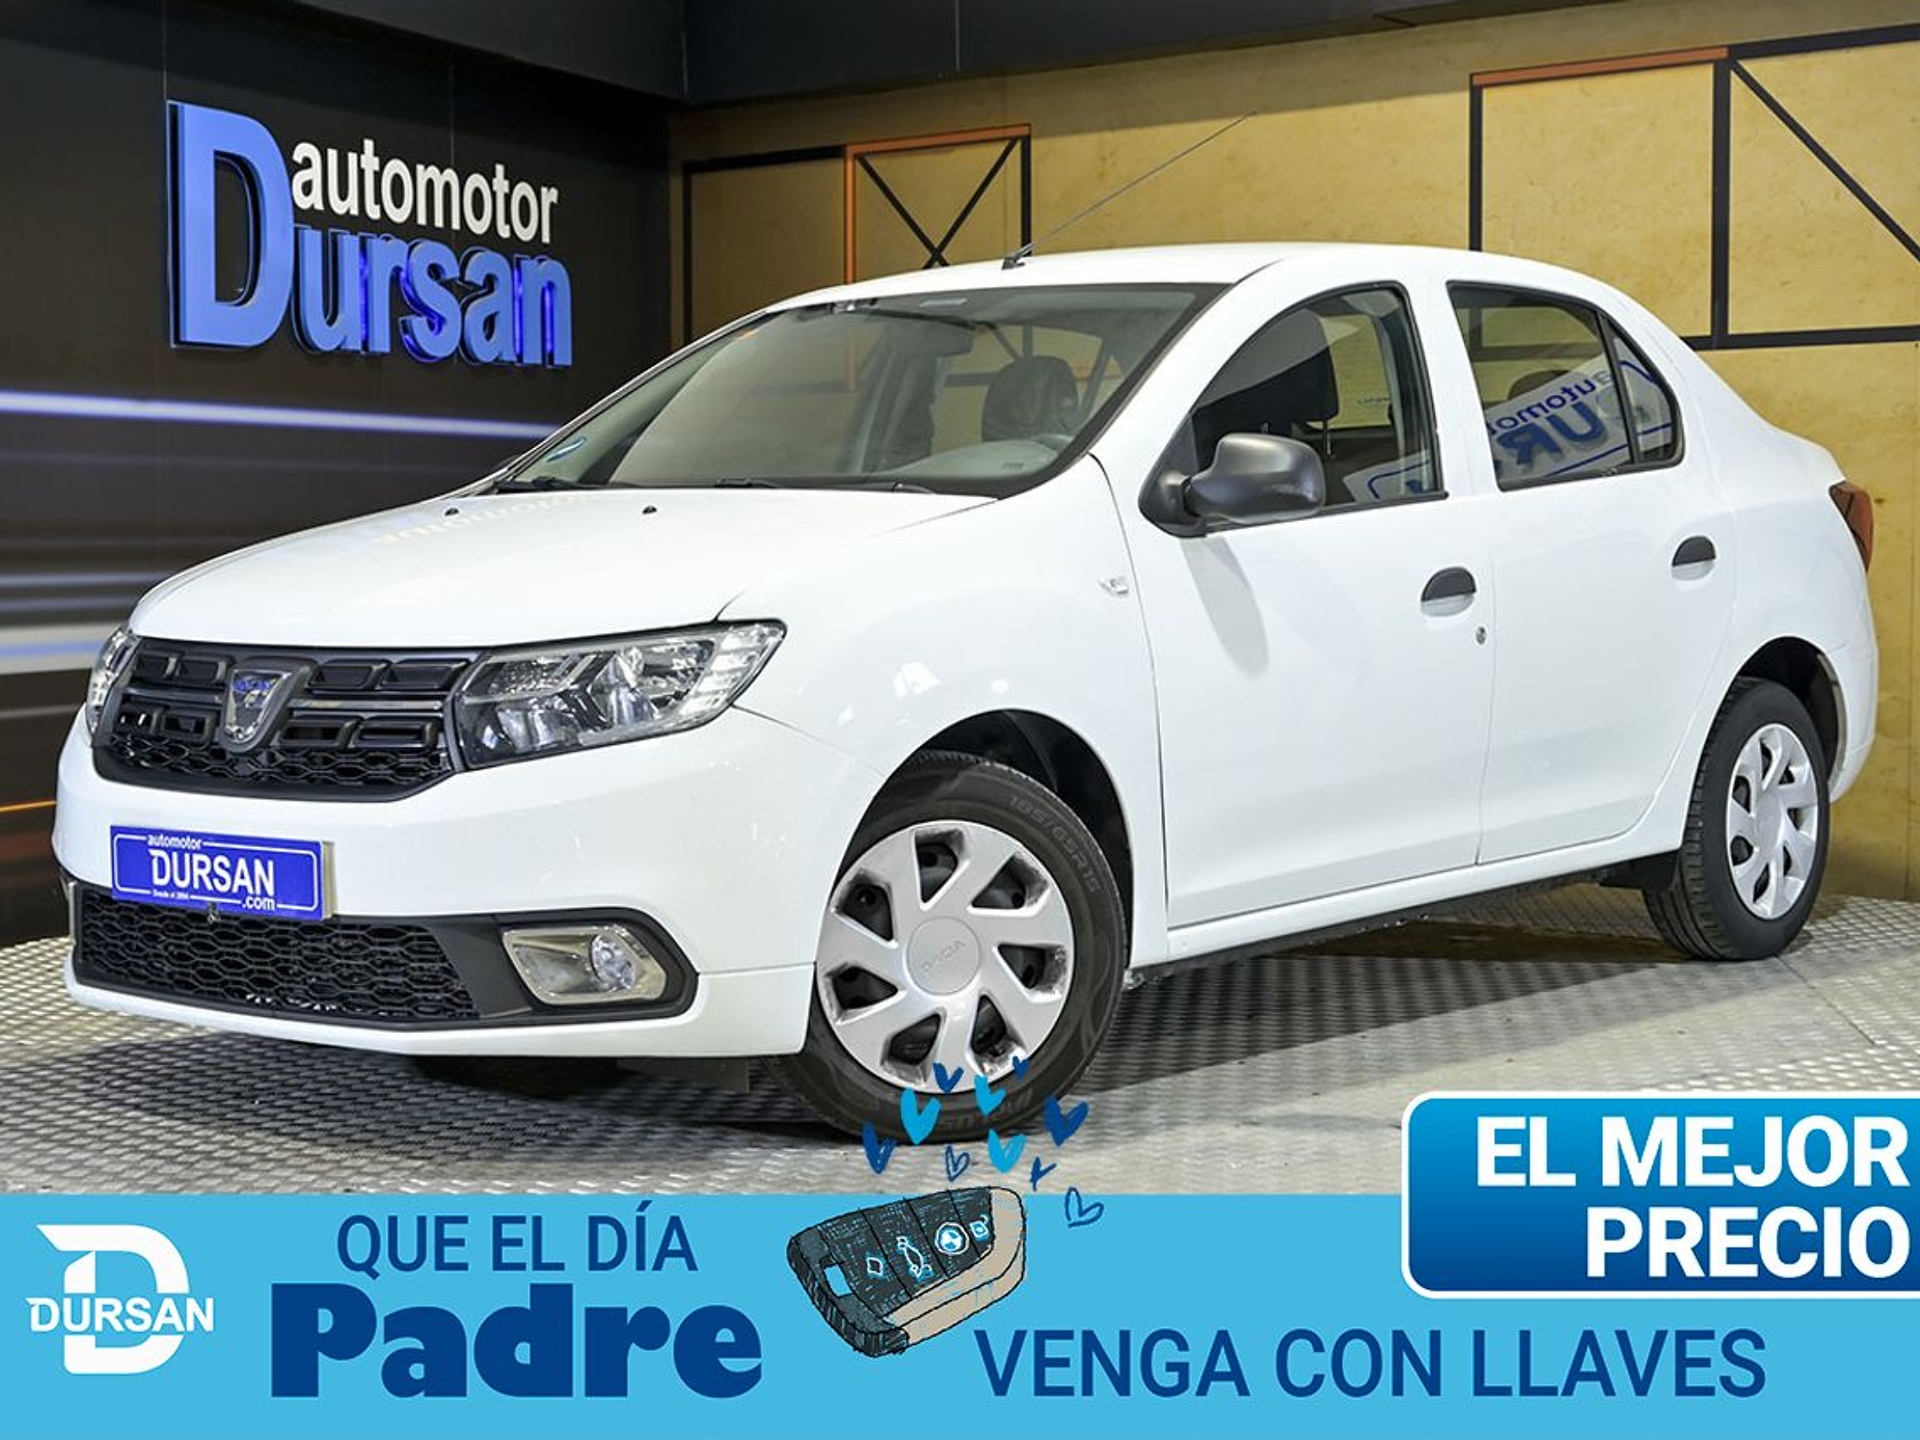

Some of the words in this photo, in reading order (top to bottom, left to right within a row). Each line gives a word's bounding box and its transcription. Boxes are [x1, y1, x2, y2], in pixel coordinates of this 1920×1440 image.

[291, 138, 559, 244] automotor
[167, 100, 572, 367] Dursan
[147, 834, 203, 850] automotor
[149, 849, 275, 897] DURSAN
[242, 895, 276, 911] .com
